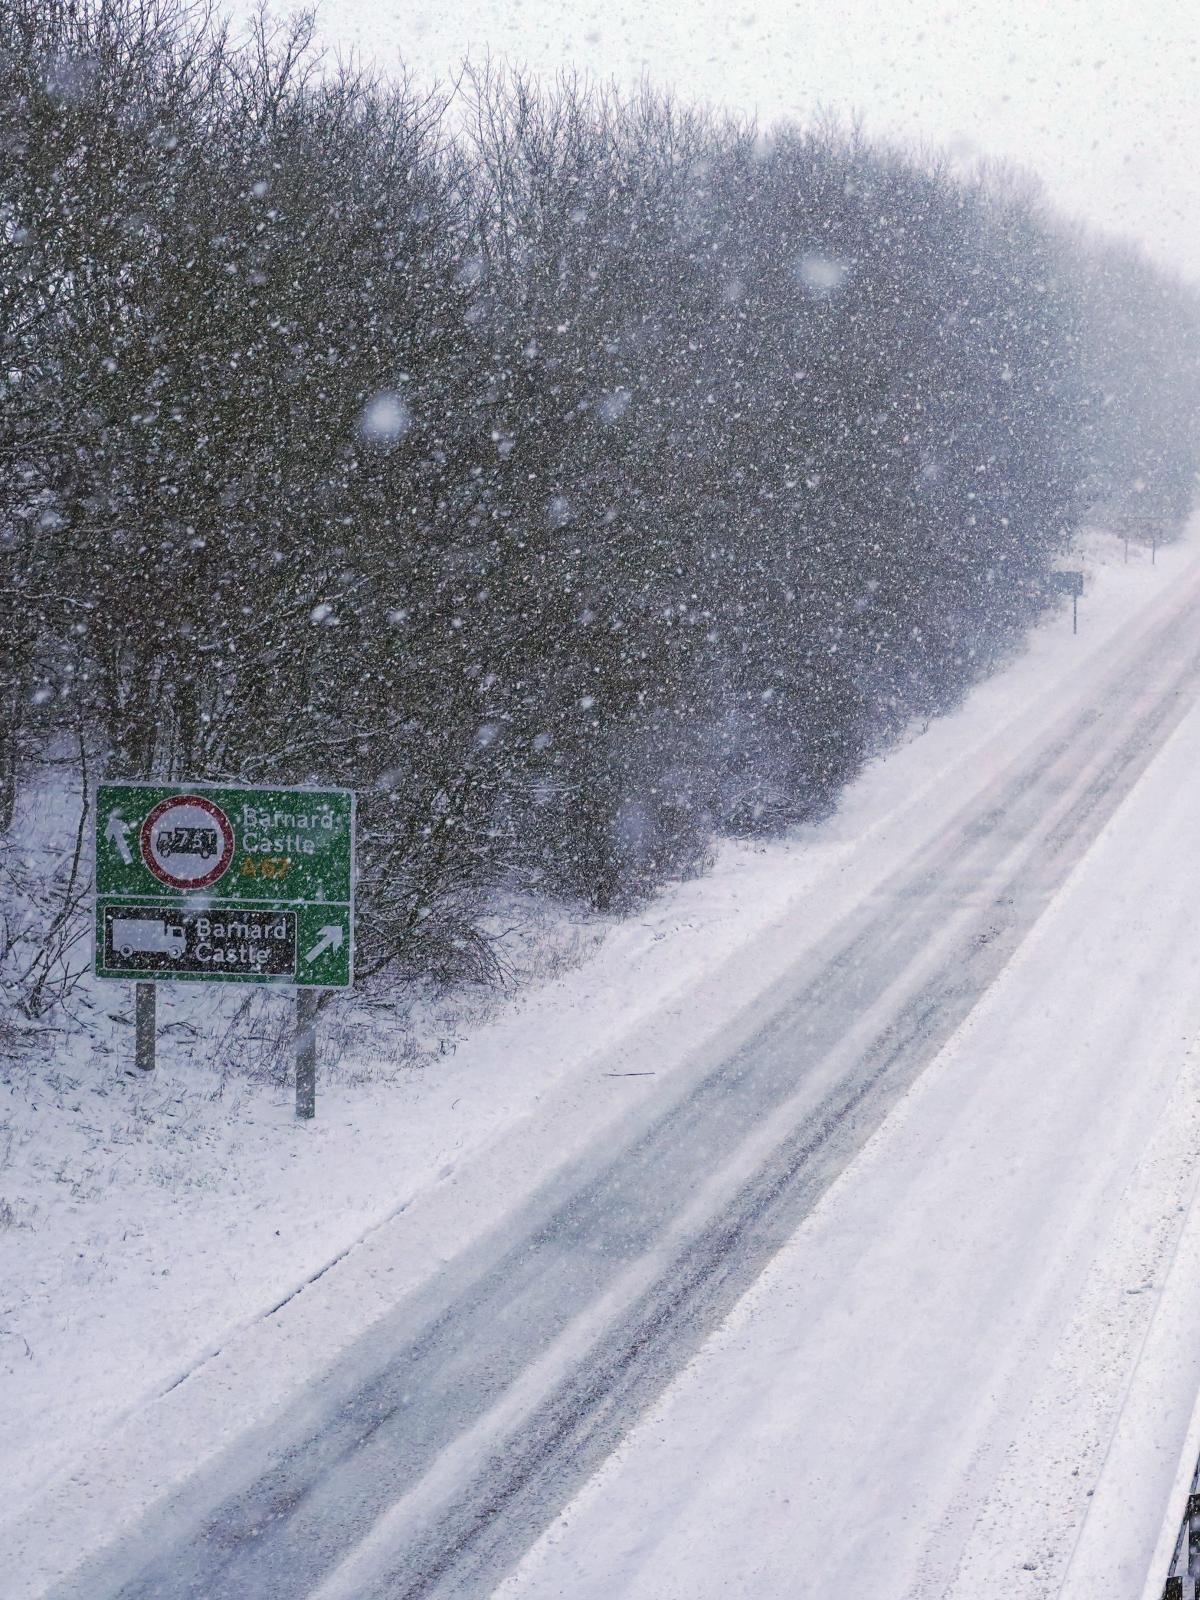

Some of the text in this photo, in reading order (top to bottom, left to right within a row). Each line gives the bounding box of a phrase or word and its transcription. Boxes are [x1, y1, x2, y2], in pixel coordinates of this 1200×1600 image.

[243, 806, 333, 830] Barnard
[243, 833, 316, 856] Castle
[196, 917, 286, 939] Barnard
[195, 942, 269, 964] Castle
